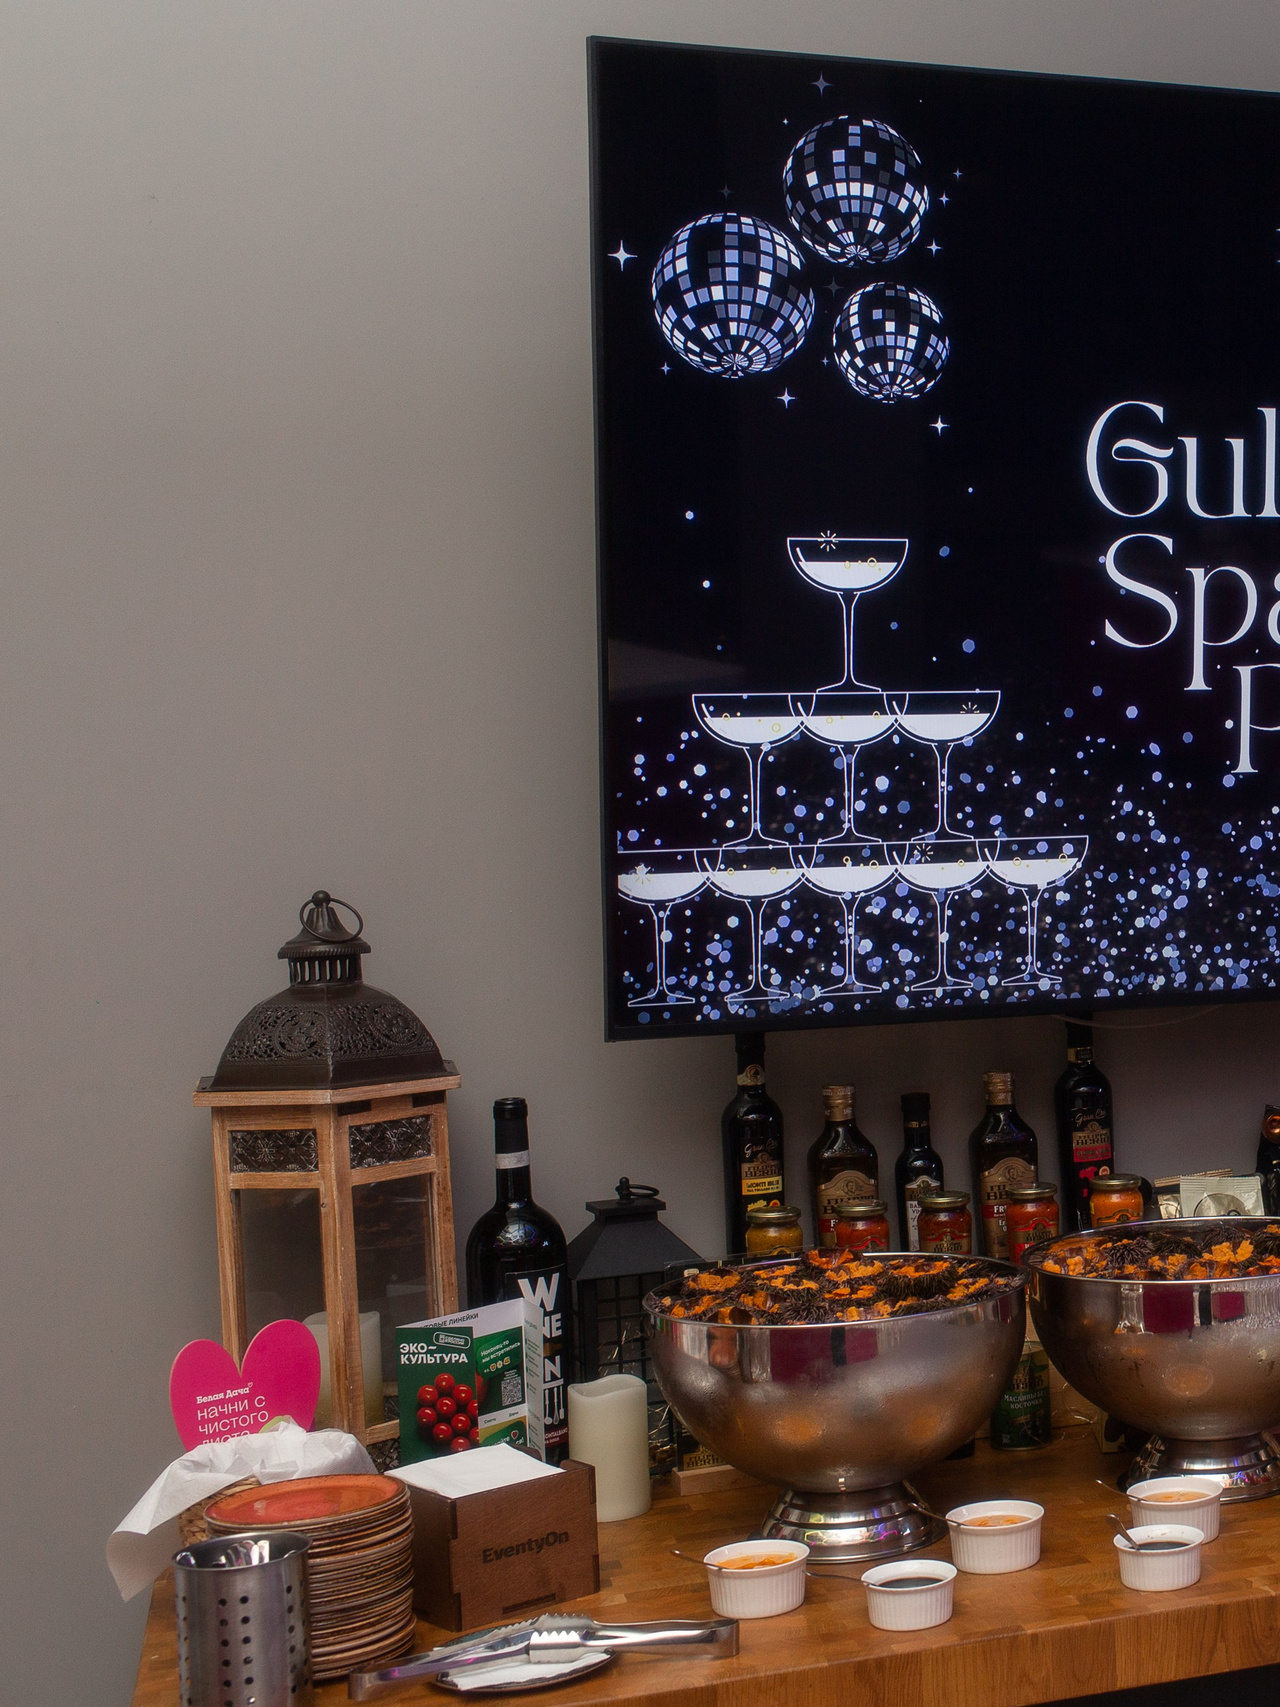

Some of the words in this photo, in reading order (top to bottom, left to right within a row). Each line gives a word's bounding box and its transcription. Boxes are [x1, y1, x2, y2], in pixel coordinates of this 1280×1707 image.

[448, 1313, 479, 1327] ЛИНЕЙКИ
[400, 1353, 469, 1365] КУЛЬТУРА
[196, 1392, 224, 1405] Белая
[225, 1386, 250, 1399] Дача
[197, 1399, 249, 1420] начни
[198, 1410, 269, 1435] чистого
[482, 1531, 570, 1565] EventyOn
